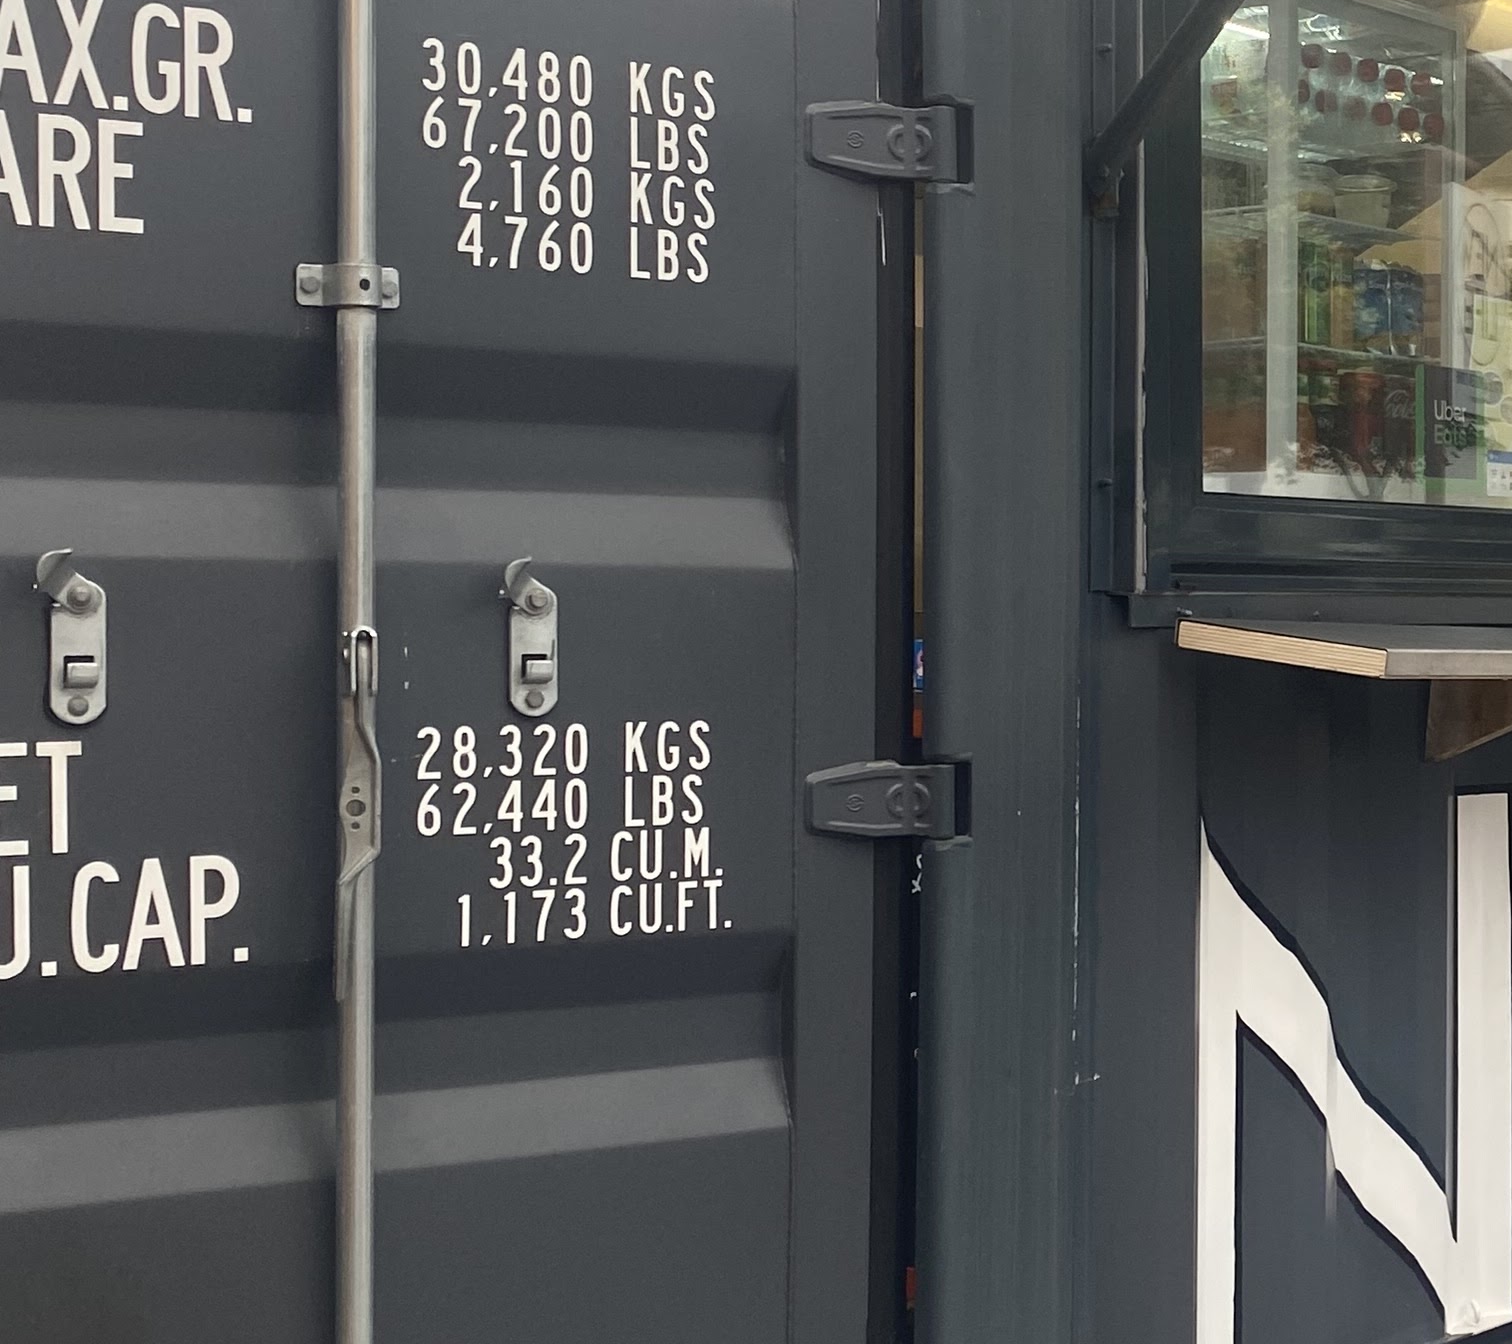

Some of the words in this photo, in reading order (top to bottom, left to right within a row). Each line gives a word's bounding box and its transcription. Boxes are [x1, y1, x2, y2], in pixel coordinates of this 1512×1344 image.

[422, 37, 593, 107] 30,480
[629, 61, 716, 121] KGS
[422, 97, 593, 163] 67,200
[630, 116, 709, 175] LBS
[458, 155, 593, 218] 2,160
[630, 171, 716, 230] KGS
[457, 213, 593, 274] 4,760
[630, 226, 709, 283] LBS
[1434, 399, 1467, 423] Uber
[1434, 423, 1467, 447] Eats
[416, 723, 588, 780] 28,320
[625, 720, 711, 773] KGS
[417, 777, 588, 837] 62,440
[624, 773, 704, 827] LBS
[489, 832, 588, 889] 33.2
[610, 826, 724, 882] CU.M.
[458, 887, 587, 947] 1,173
[610, 879, 732, 936] CU.FT.
